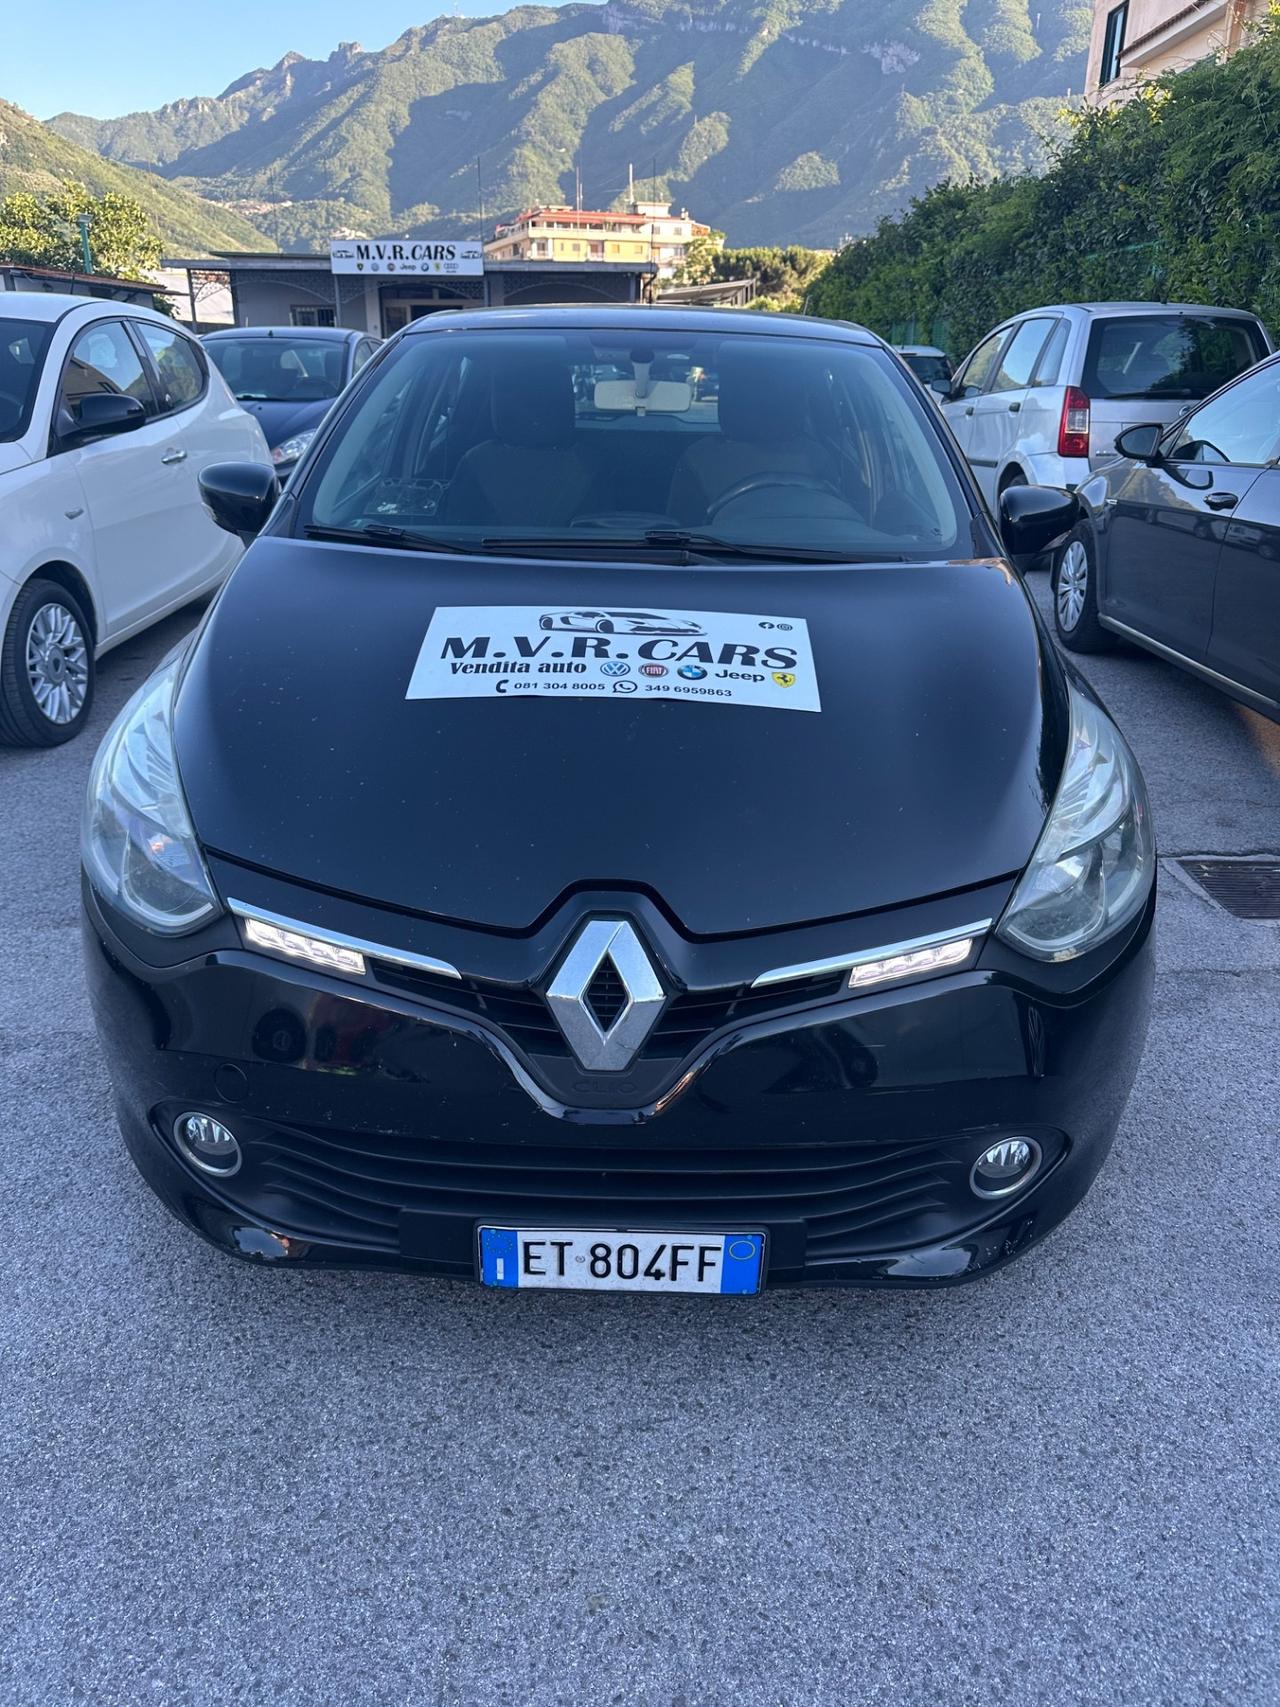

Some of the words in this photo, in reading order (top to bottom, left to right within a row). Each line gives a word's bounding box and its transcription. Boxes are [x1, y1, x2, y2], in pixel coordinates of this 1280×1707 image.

[400, 264, 417, 272] Jeep
[451, 661, 531, 675] Vendita
[538, 661, 587, 674] auto
[715, 669, 766, 683] Jeep
[514, 682, 538, 690] 081
[543, 682, 568, 690] 304
[572, 683, 606, 691] 8005
[645, 684, 670, 692] 349
[674, 686, 733, 697] 6959863
[523, 1241, 573, 1277] ET
[589, 1243, 722, 1282] 804FF
